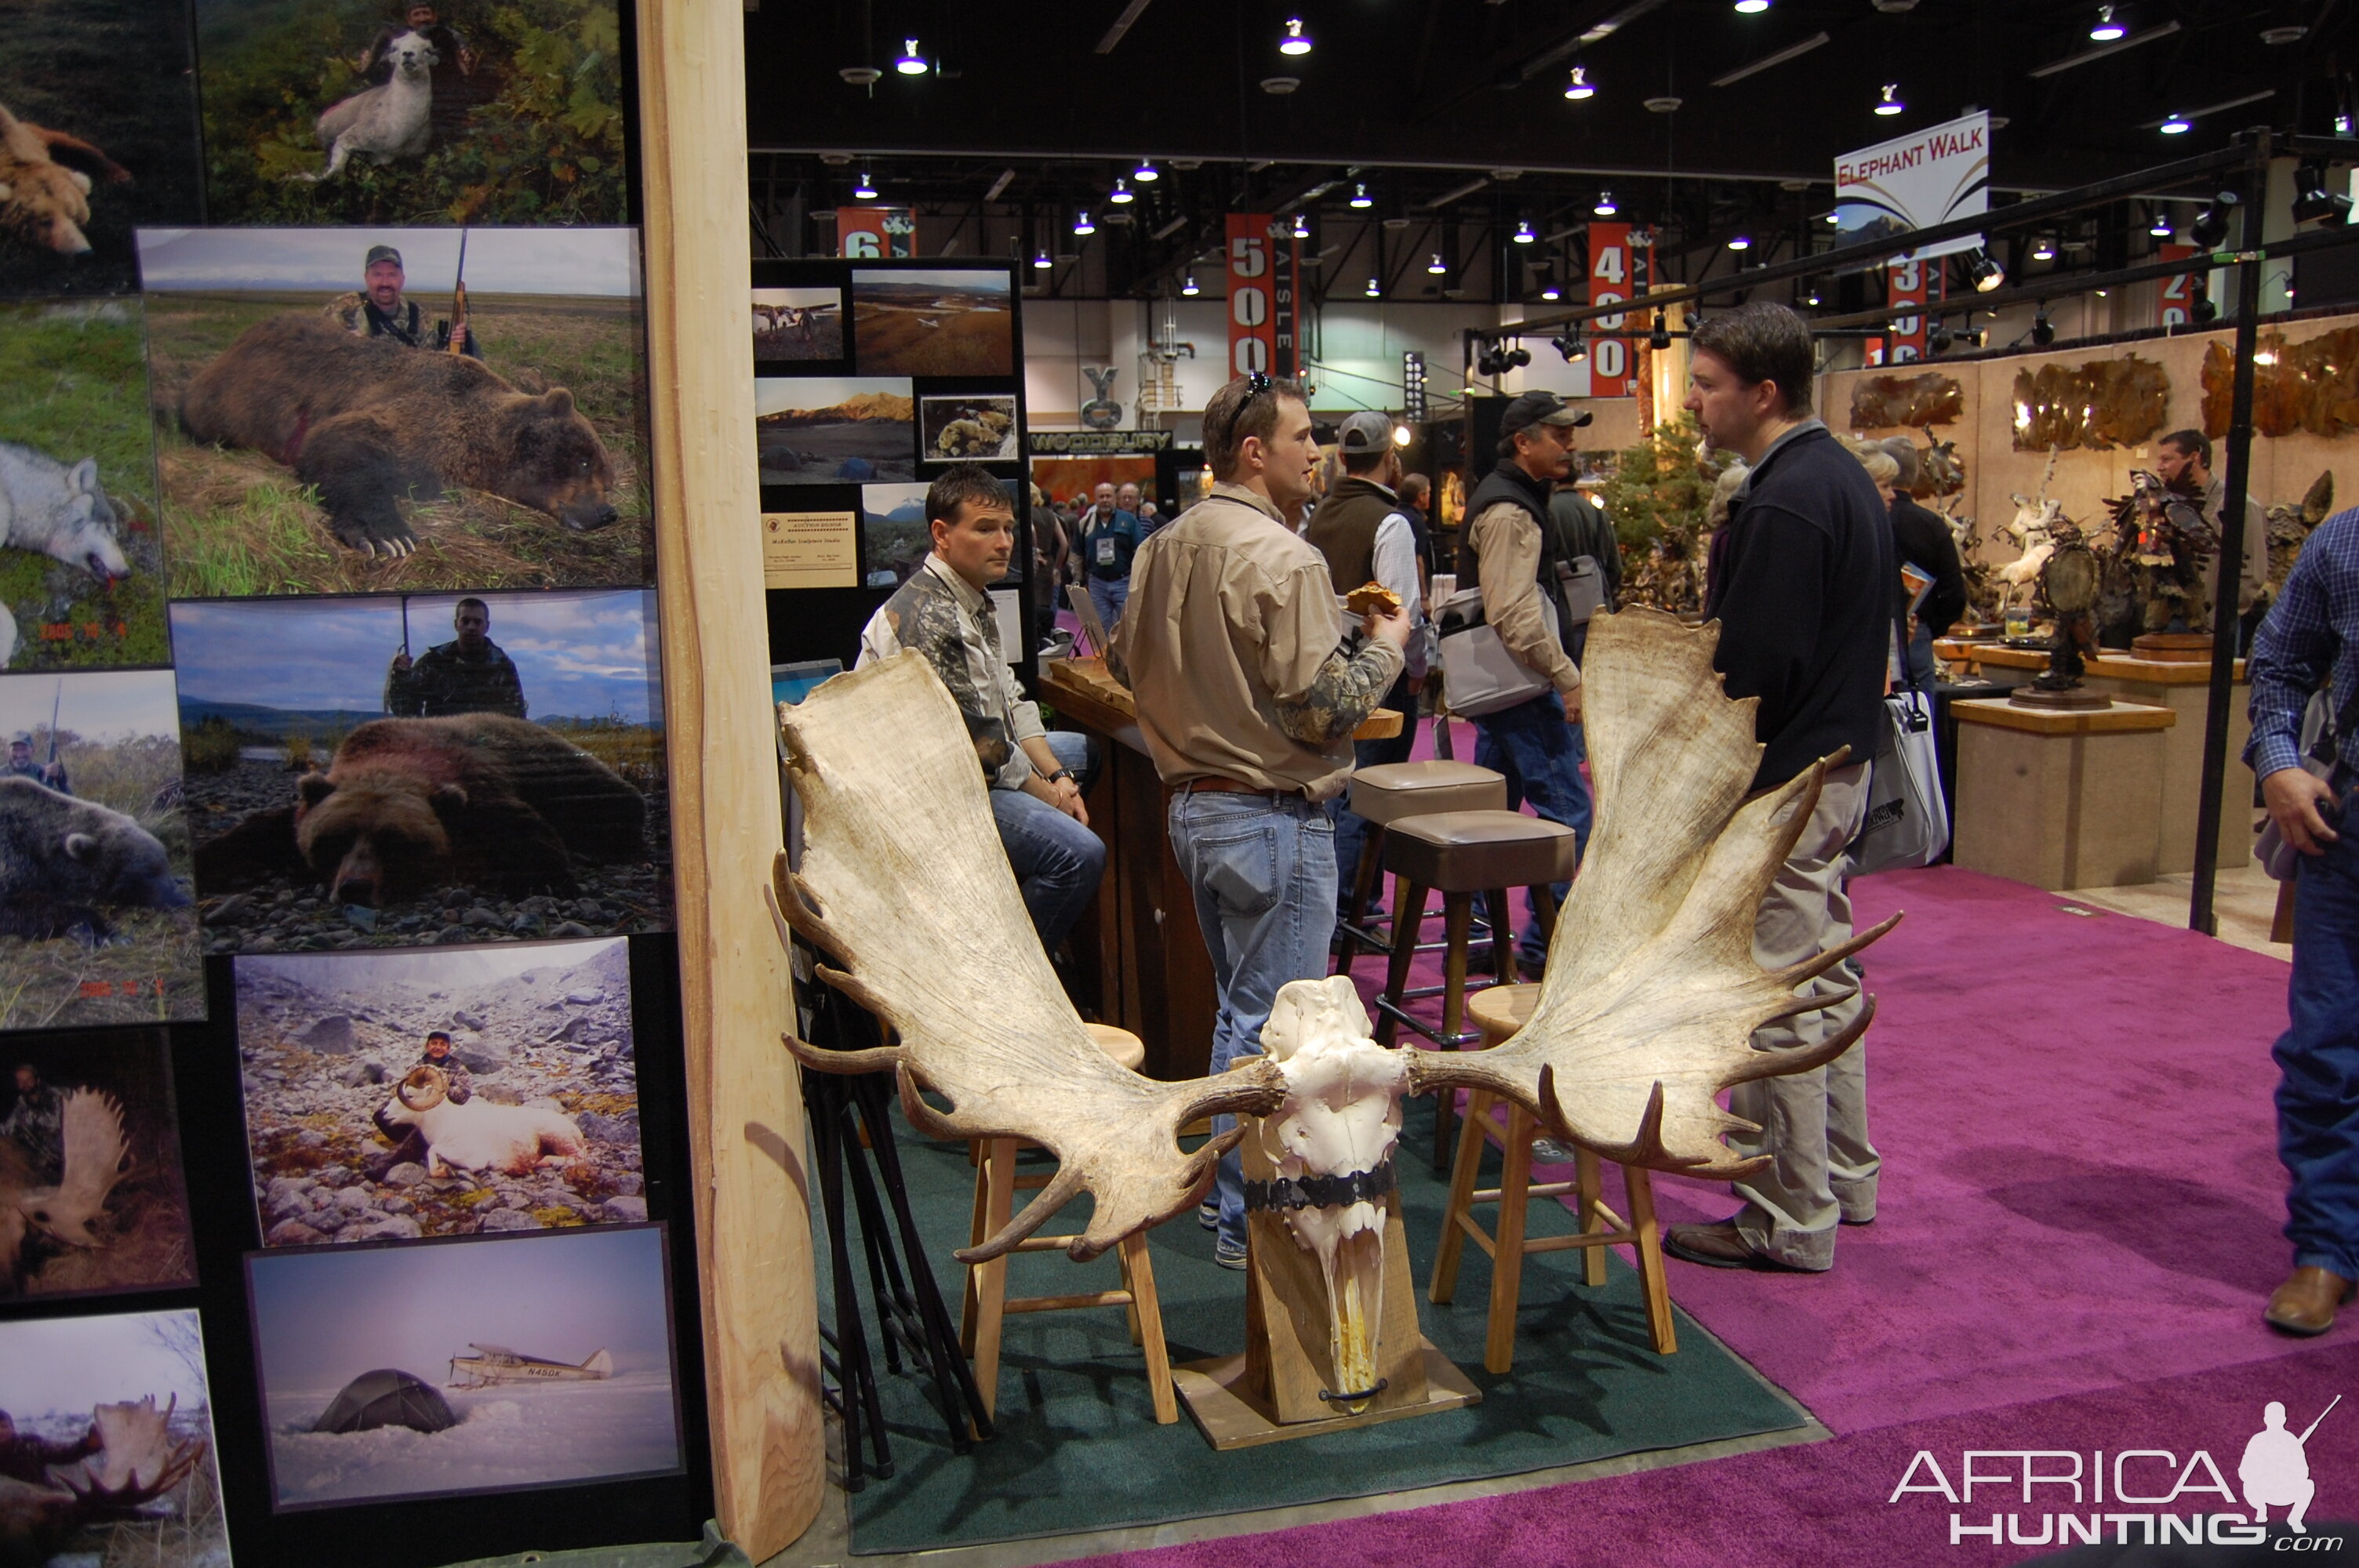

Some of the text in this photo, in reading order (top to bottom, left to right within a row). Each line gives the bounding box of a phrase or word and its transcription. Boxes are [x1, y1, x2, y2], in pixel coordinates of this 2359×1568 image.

[1838, 127, 1983, 187] ELEPHANT WALK
[1233, 238, 1267, 376] 500
[1275, 249, 1292, 350] AISLE
[1595, 247, 1625, 377] 400
[1030, 432, 1172, 451] WOODBURY
